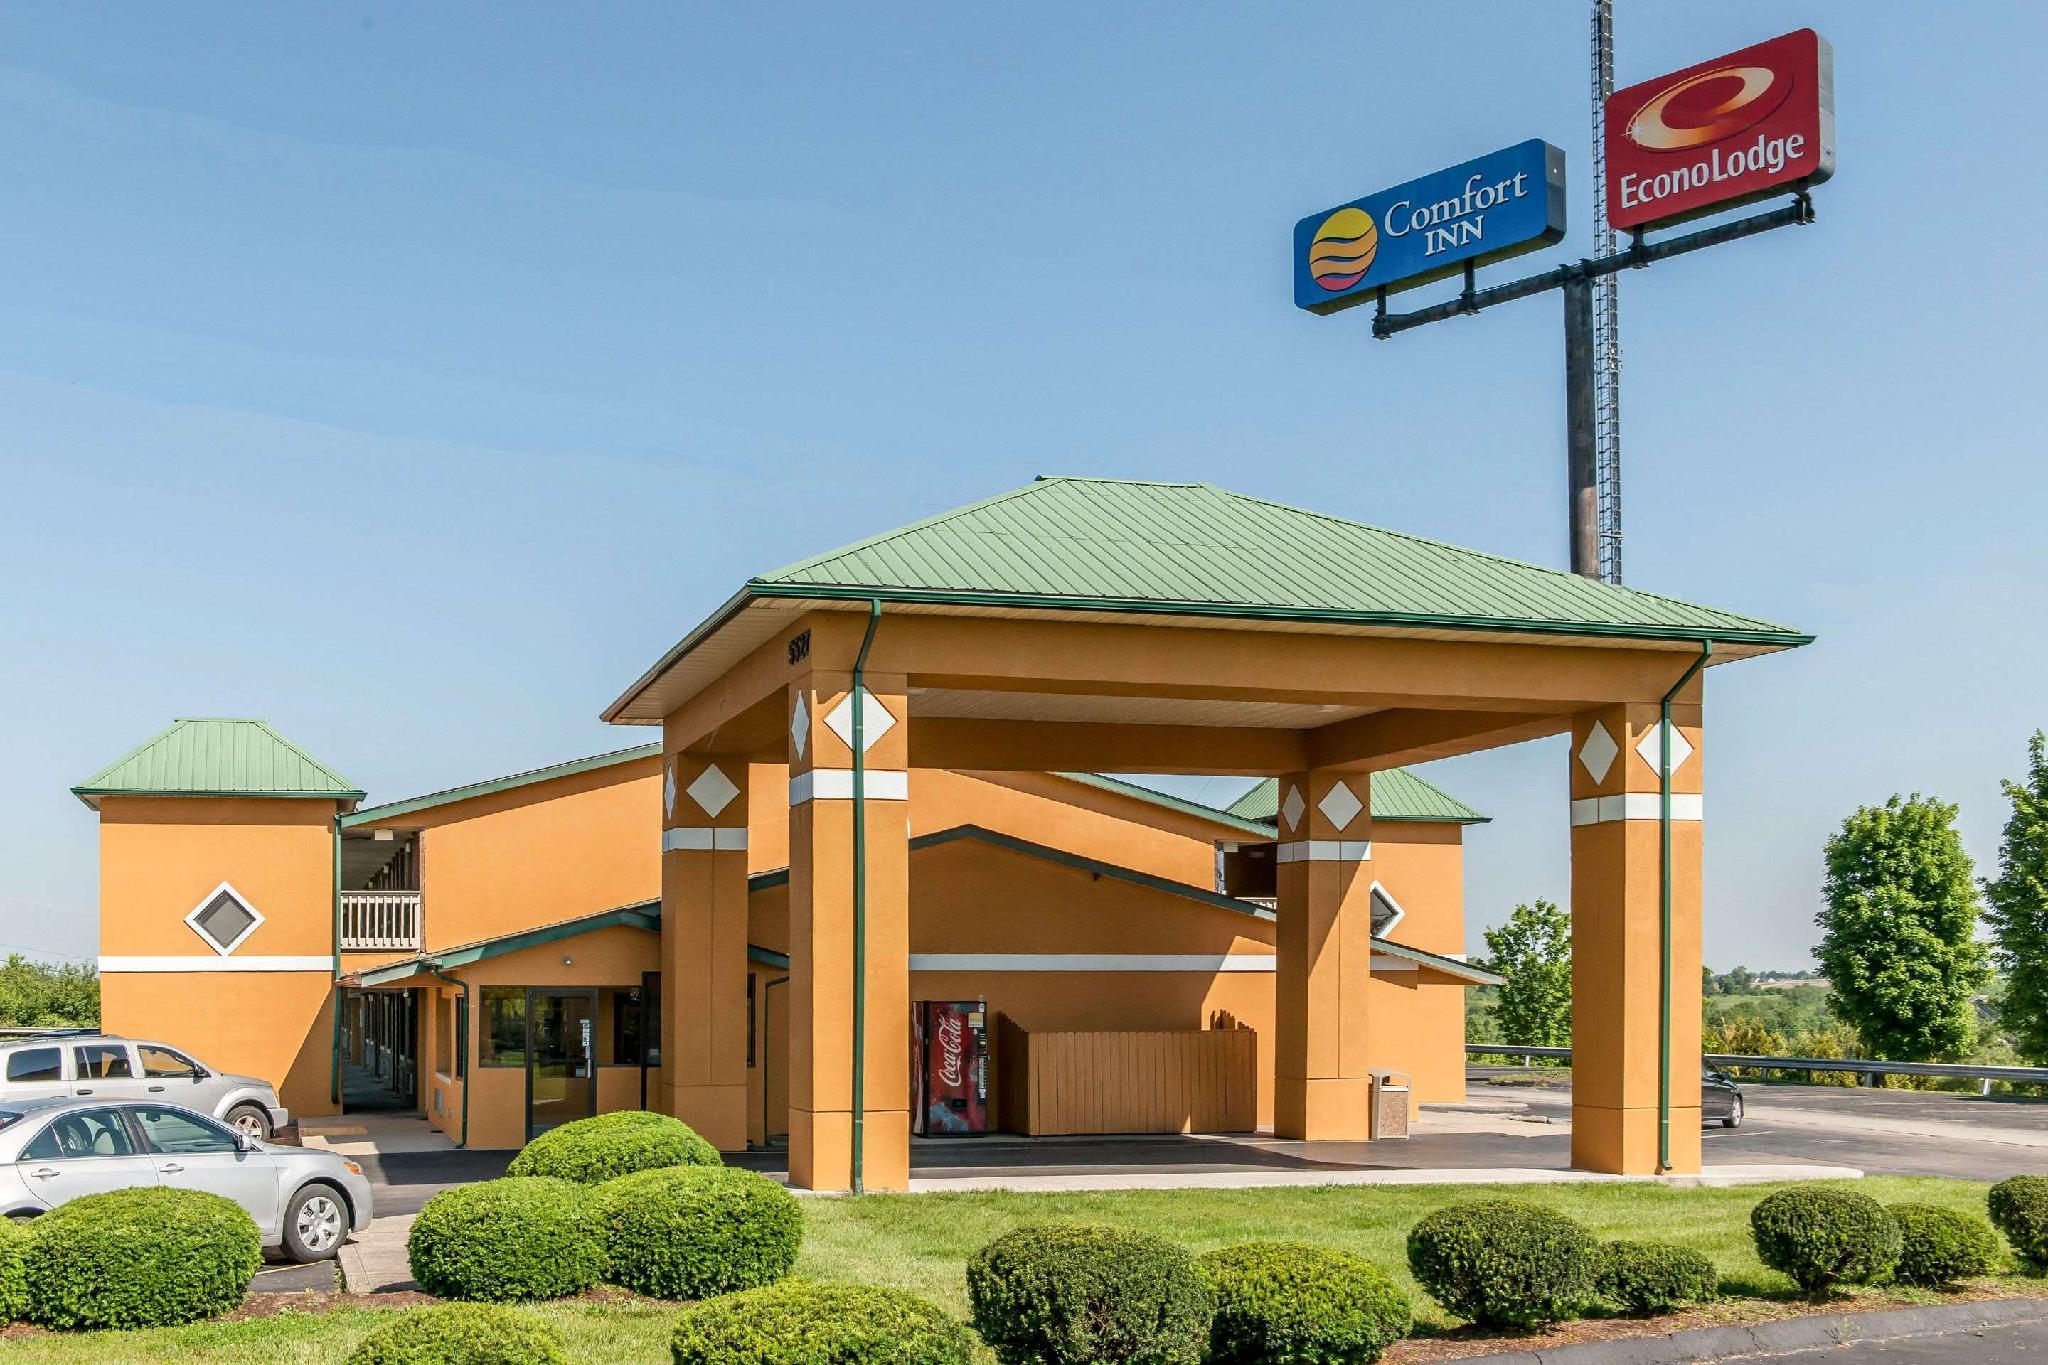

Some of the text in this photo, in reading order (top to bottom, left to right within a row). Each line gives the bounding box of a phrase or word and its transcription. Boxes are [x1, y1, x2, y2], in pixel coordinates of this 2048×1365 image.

[1384, 171, 1529, 237] Comfort
[1620, 133, 1805, 209] EconoLodge
[1424, 214, 1484, 256] INN
